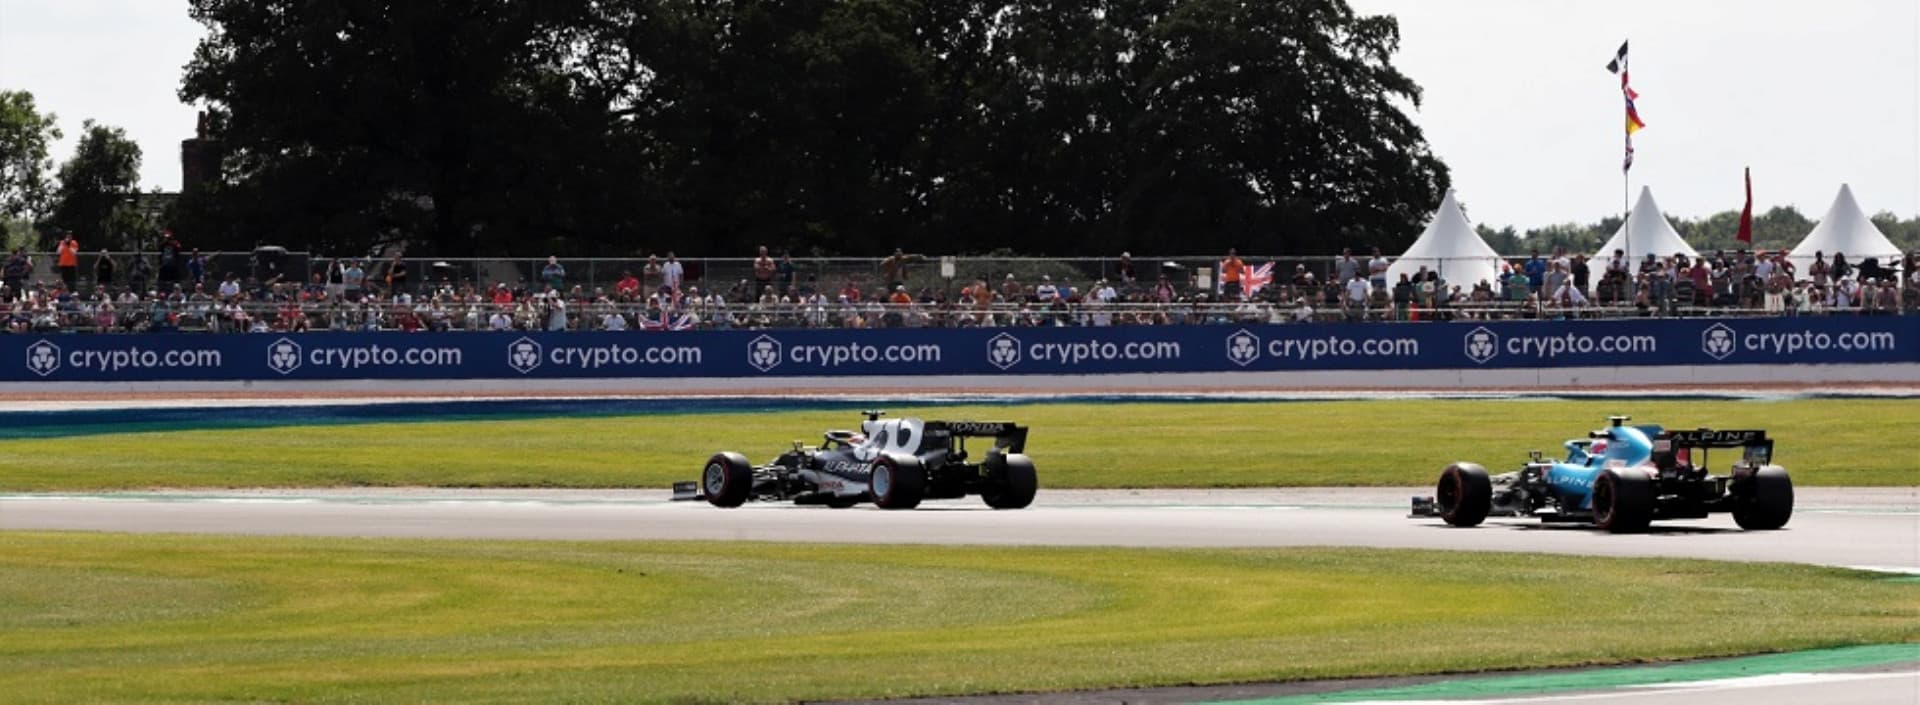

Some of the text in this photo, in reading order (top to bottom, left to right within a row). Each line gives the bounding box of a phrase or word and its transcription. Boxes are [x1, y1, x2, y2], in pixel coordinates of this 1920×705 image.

[1030, 340, 1180, 363] crypto.com
[1269, 337, 1419, 360] crypto.com
[1507, 333, 1656, 357] crypto.com
[1744, 330, 1895, 353] crypto.com
[70, 348, 221, 370] crypto.com
[310, 346, 461, 368] crypto.com
[551, 345, 701, 368] crypto.com
[791, 343, 941, 366] crypto.com
[1672, 430, 1757, 441] ALPINE
